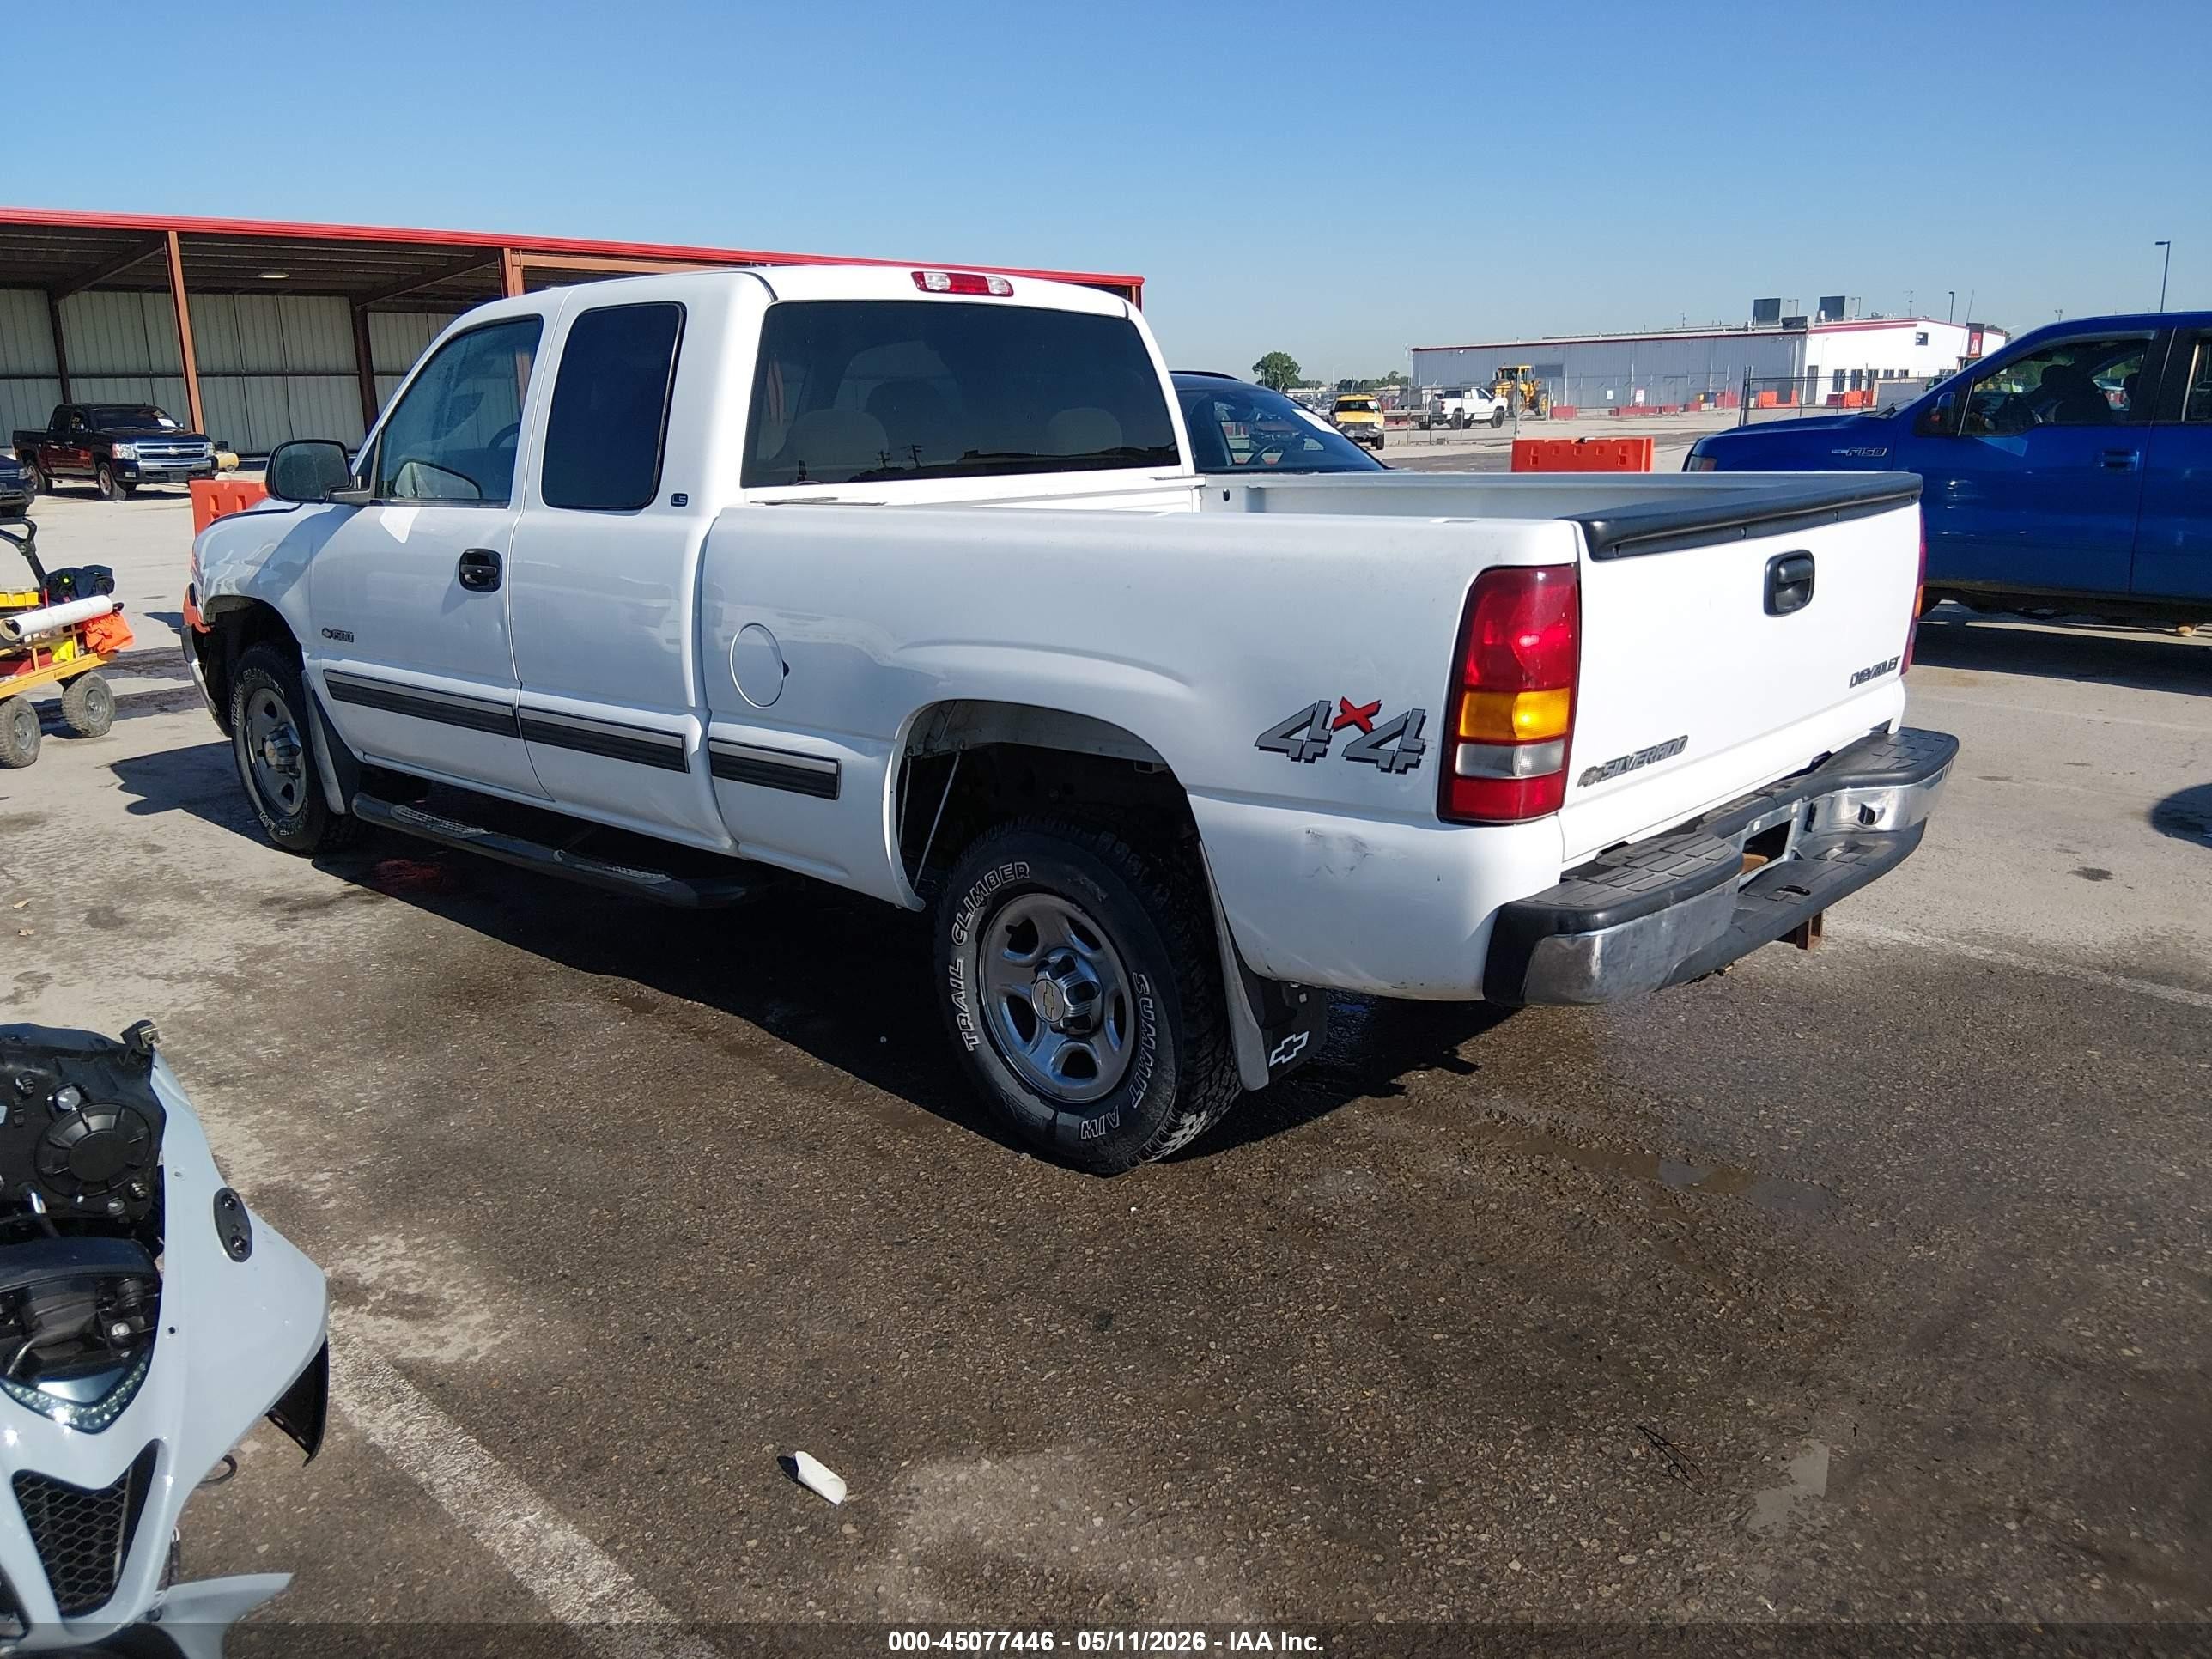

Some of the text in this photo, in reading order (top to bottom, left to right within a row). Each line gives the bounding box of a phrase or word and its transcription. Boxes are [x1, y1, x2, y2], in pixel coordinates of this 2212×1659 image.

[672, 495, 687, 505] LS
[1849, 655, 1901, 689] CHEVROLET
[1600, 734, 1689, 781] SILVERADO
[949, 861, 1030, 1052] TRAIL CLIMBER
[1127, 971, 1158, 1109] SUMMIT
